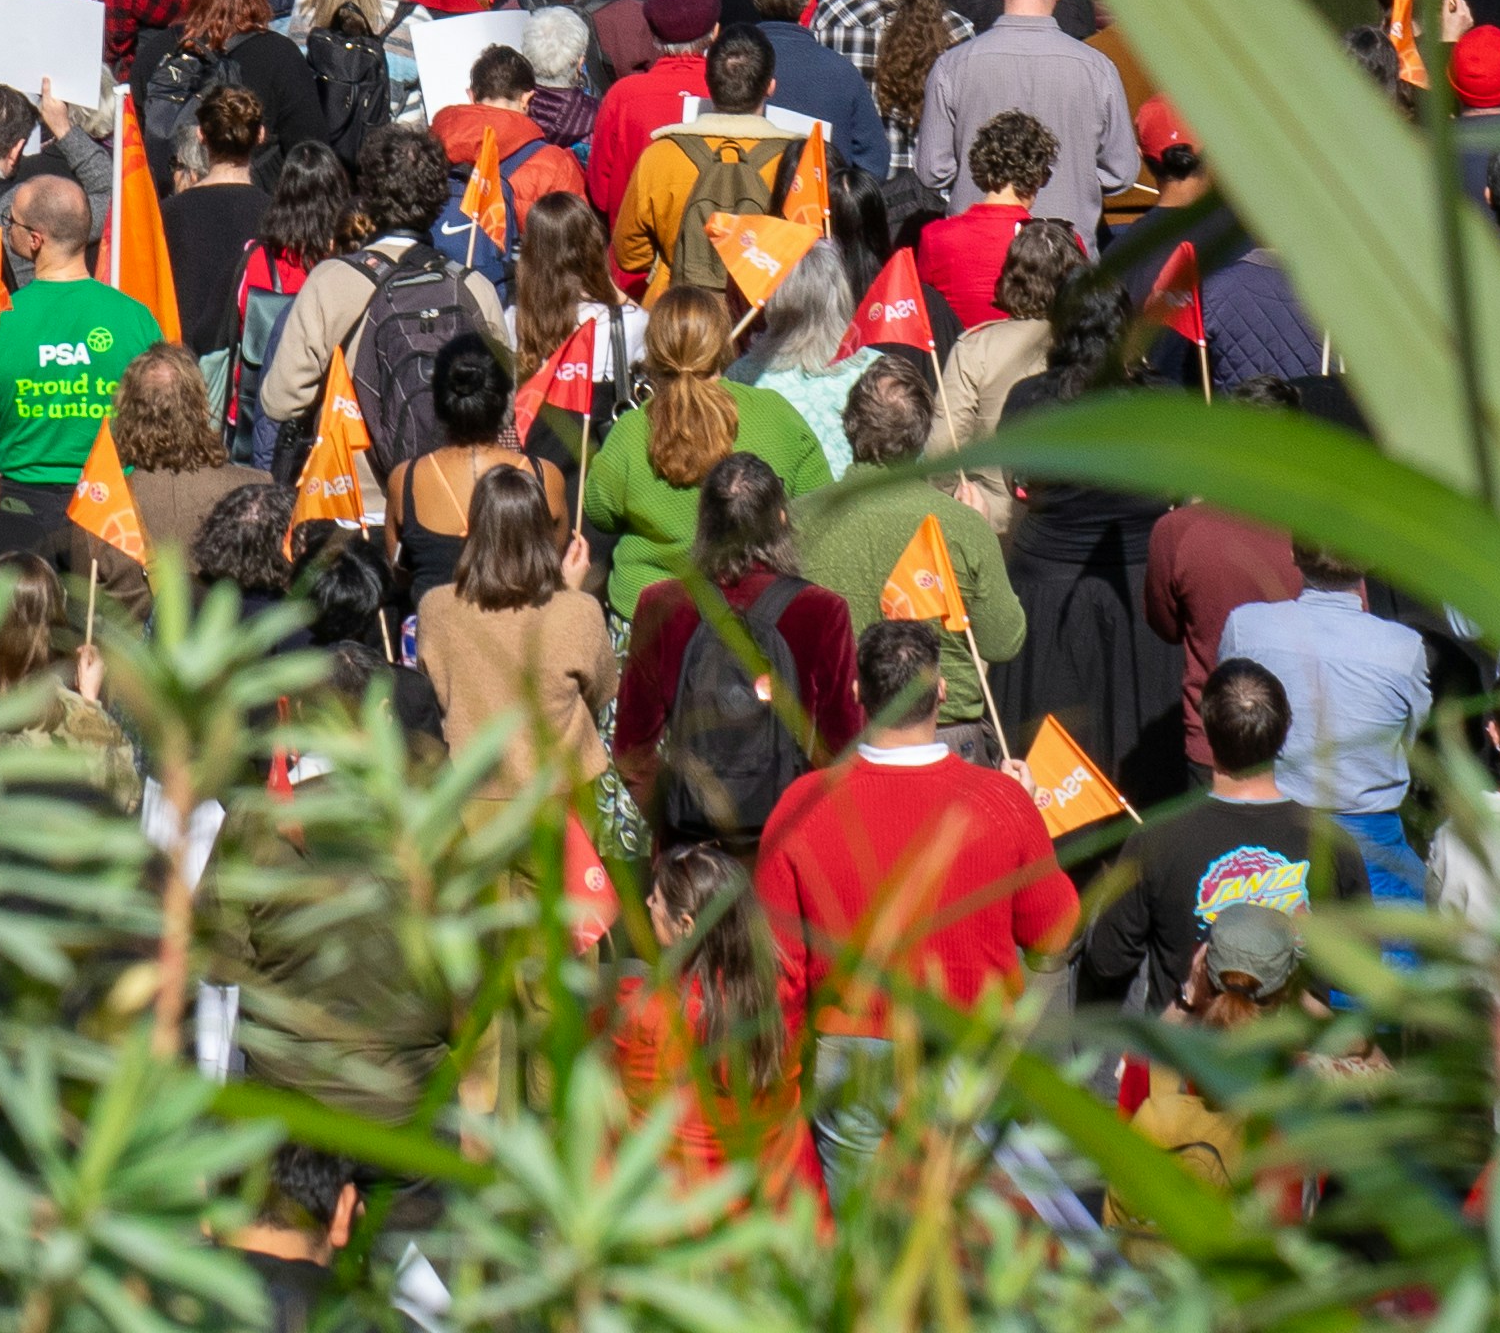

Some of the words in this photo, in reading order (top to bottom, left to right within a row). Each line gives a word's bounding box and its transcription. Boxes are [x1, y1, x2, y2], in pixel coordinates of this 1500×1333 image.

[38, 342, 91, 368] PSA
[15, 372, 89, 397] Proud
[15, 396, 44, 420] be
[1195, 860, 1310, 914] SANTA
